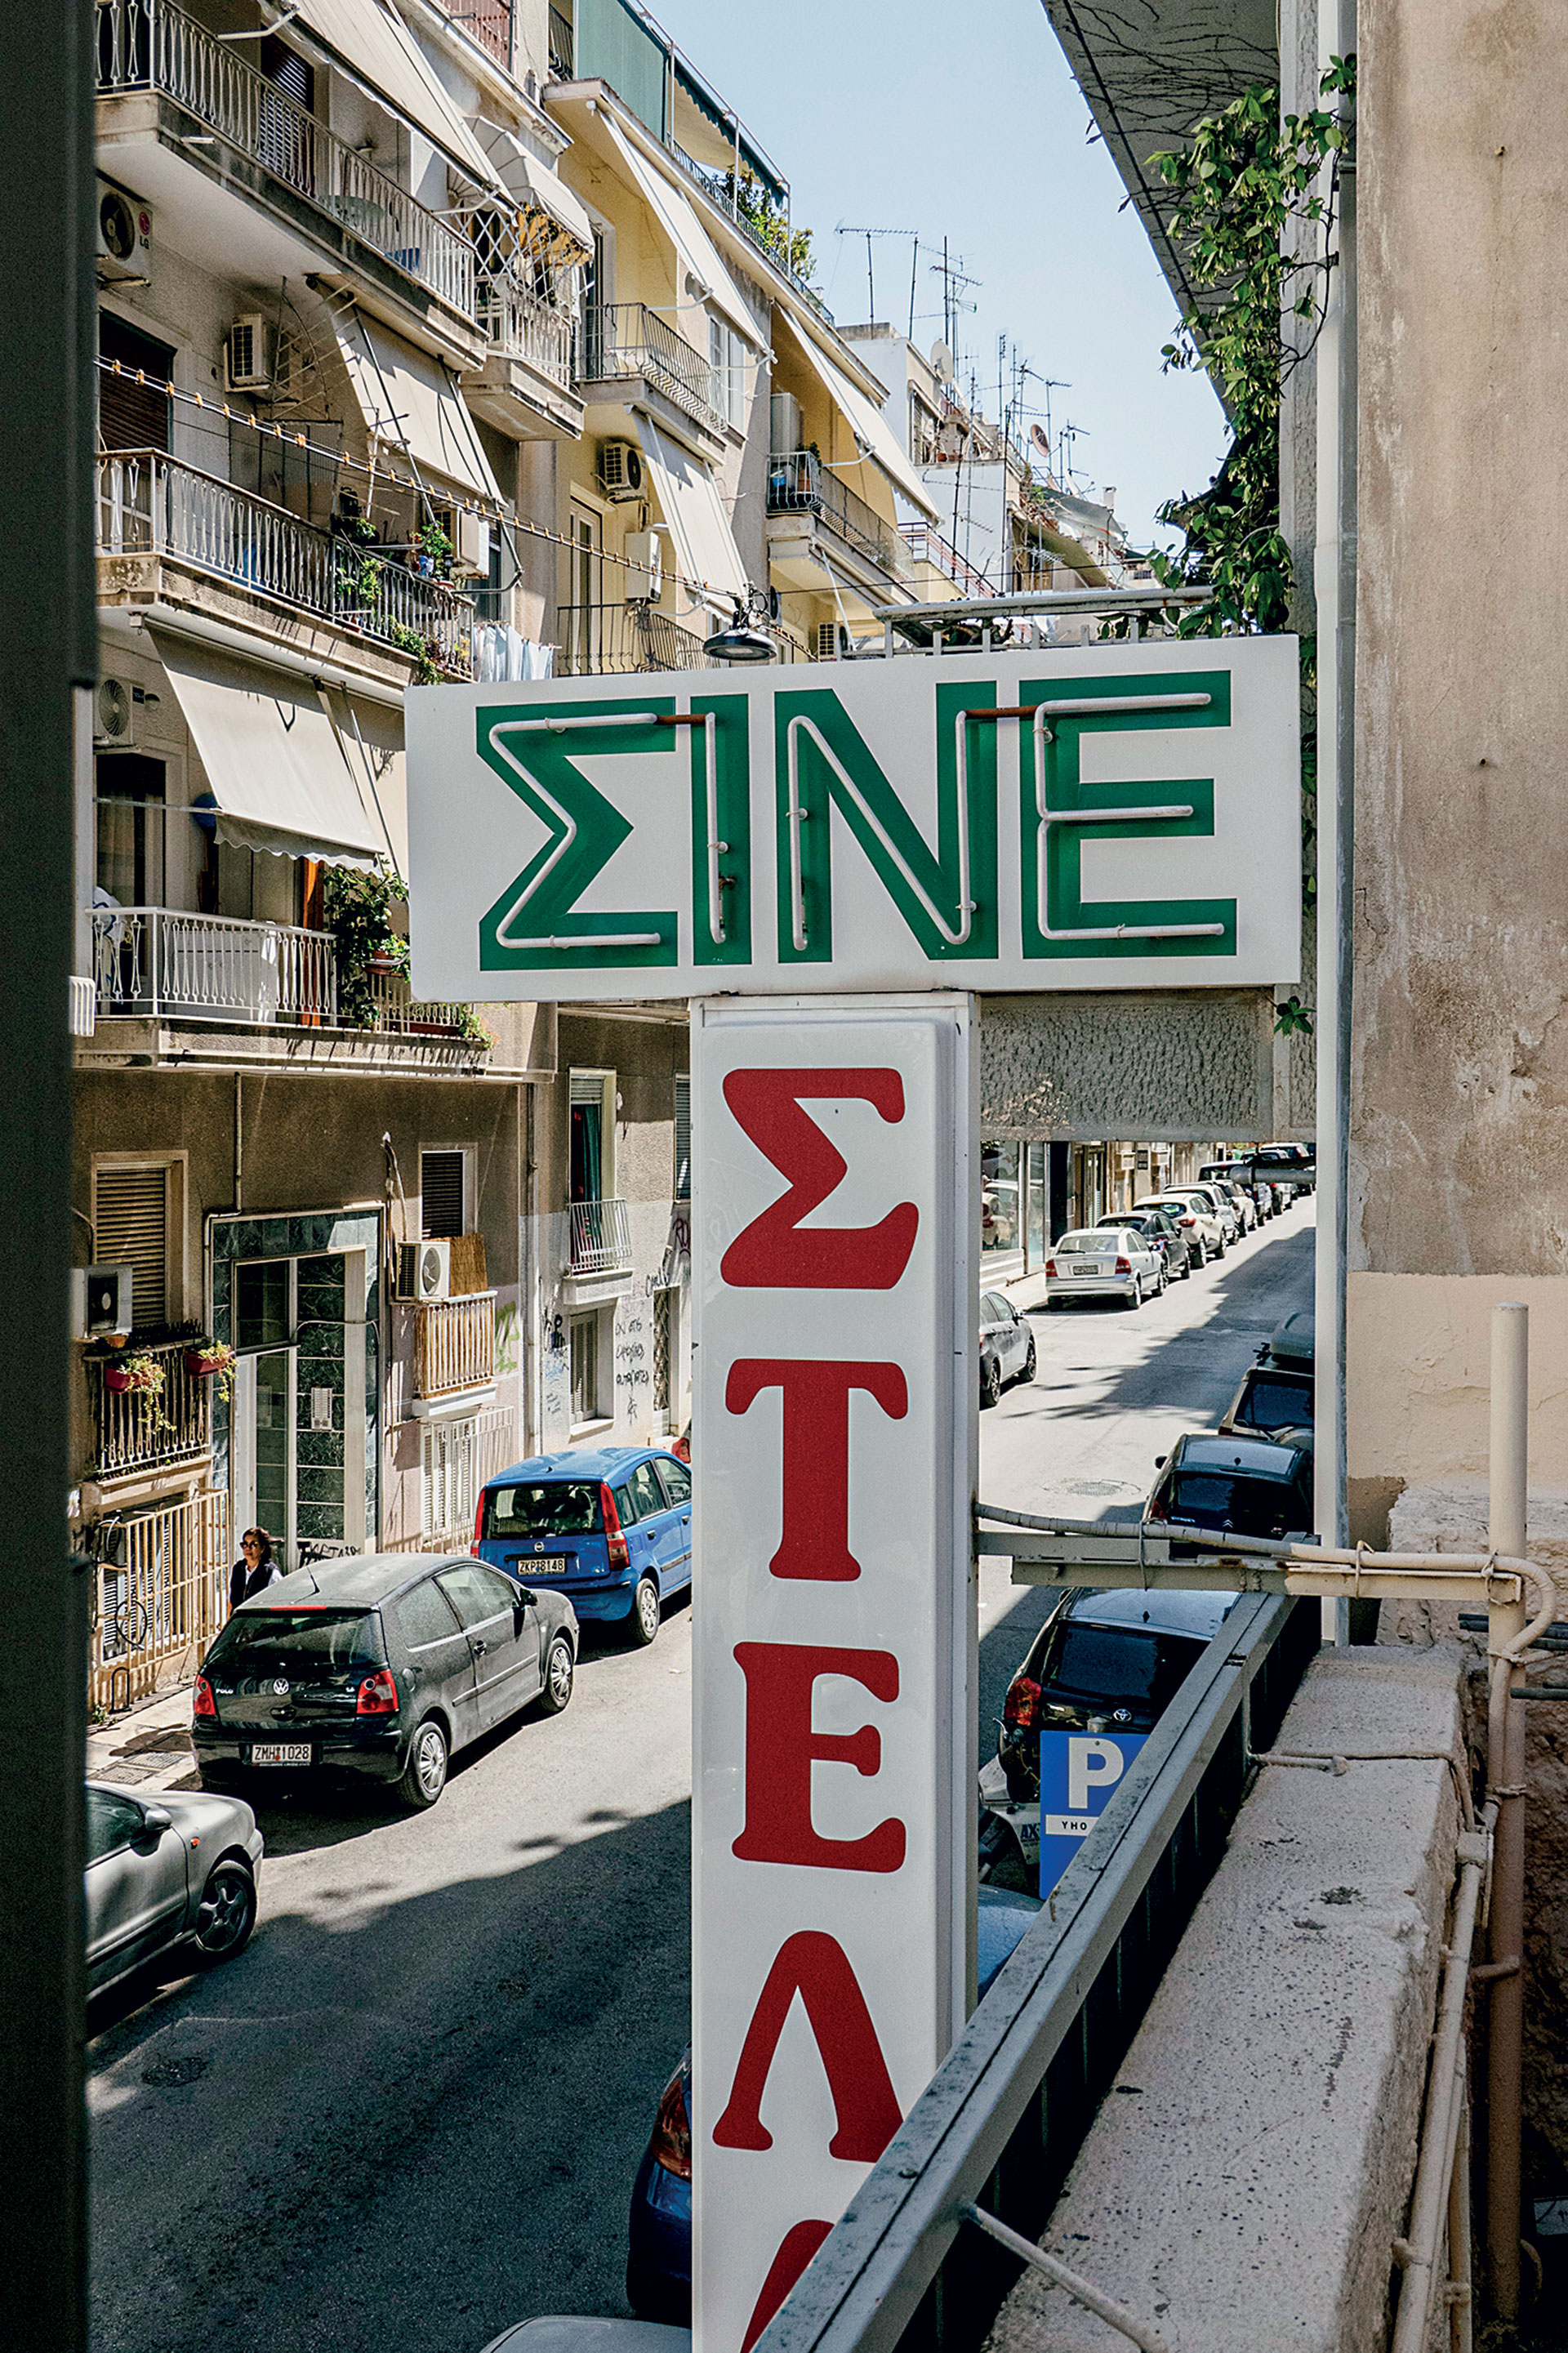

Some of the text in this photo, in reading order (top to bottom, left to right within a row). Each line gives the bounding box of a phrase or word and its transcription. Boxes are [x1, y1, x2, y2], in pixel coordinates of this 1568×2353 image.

[139, 235, 149, 250] LG
[476, 670, 1238, 971] ΣΙΝΕ
[1069, 1737, 1124, 1809] P
[1062, 1820, 1087, 1830] YHO
